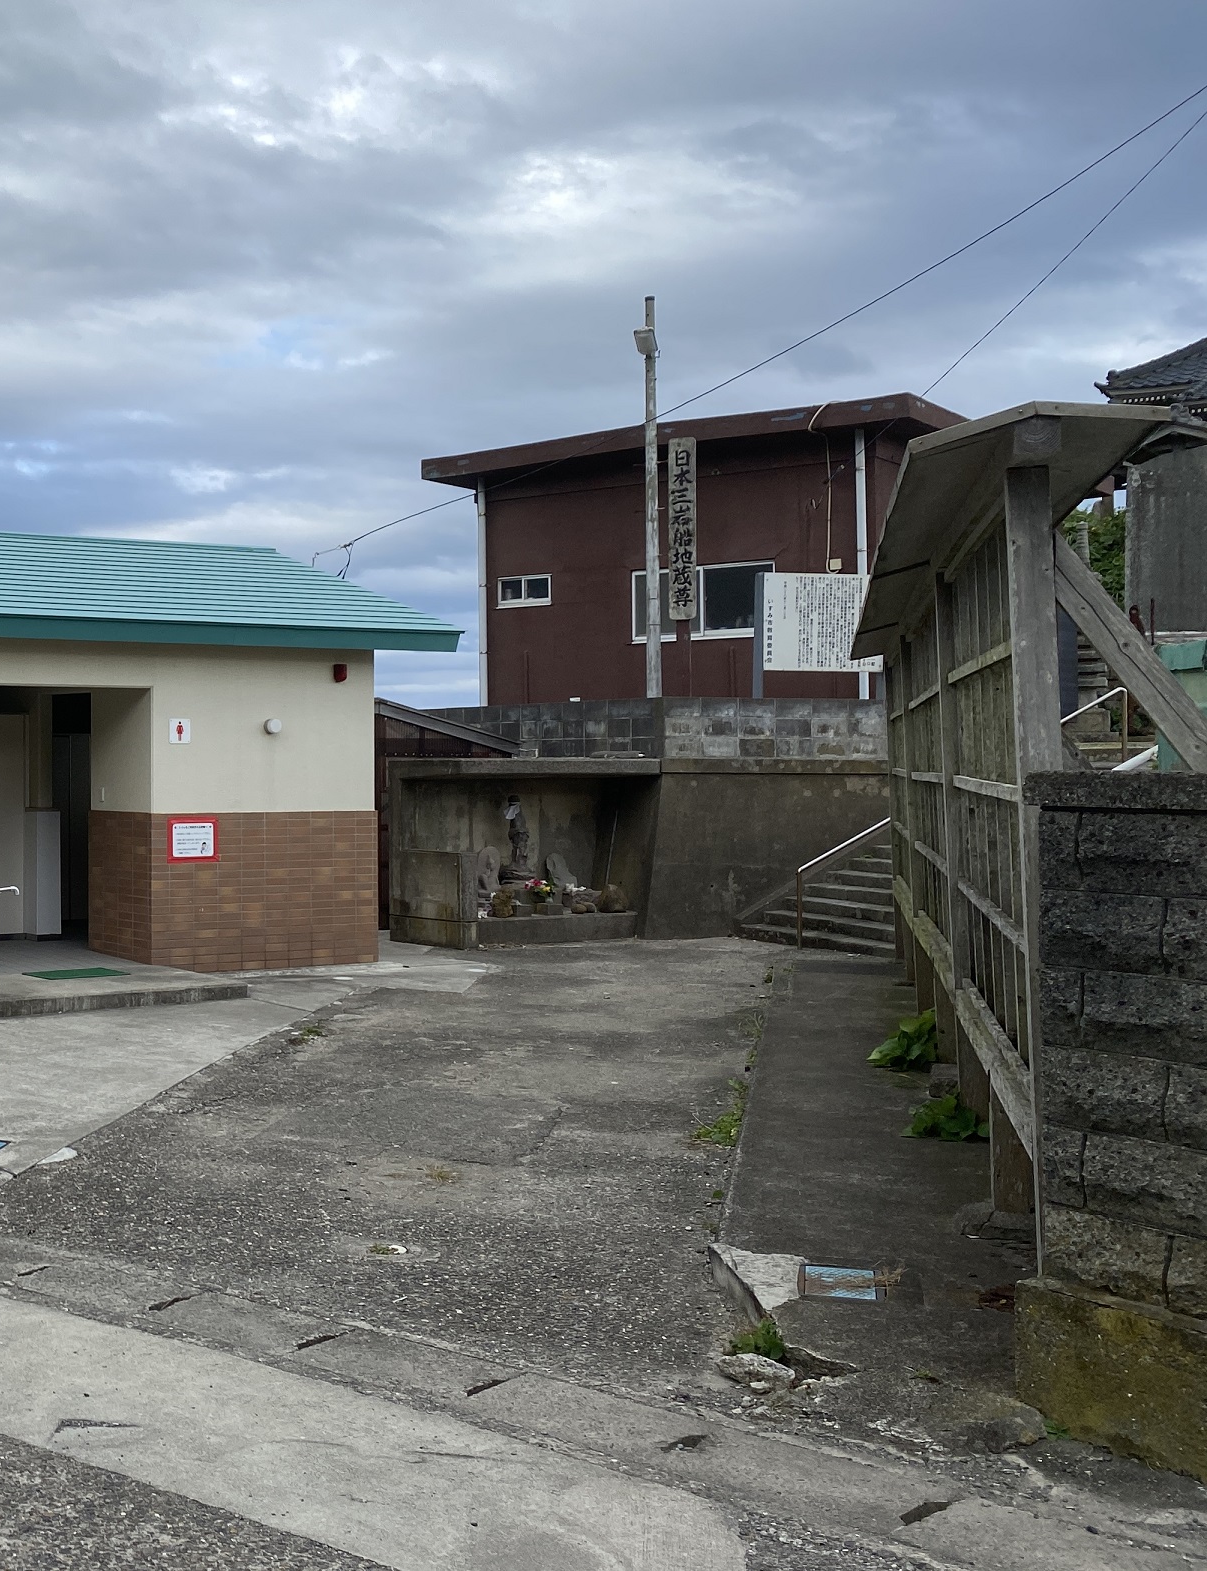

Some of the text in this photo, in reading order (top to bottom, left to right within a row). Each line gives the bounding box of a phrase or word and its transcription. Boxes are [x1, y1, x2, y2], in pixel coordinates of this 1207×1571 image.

[670, 449, 693, 607] 日本三岩船地蔵尊
